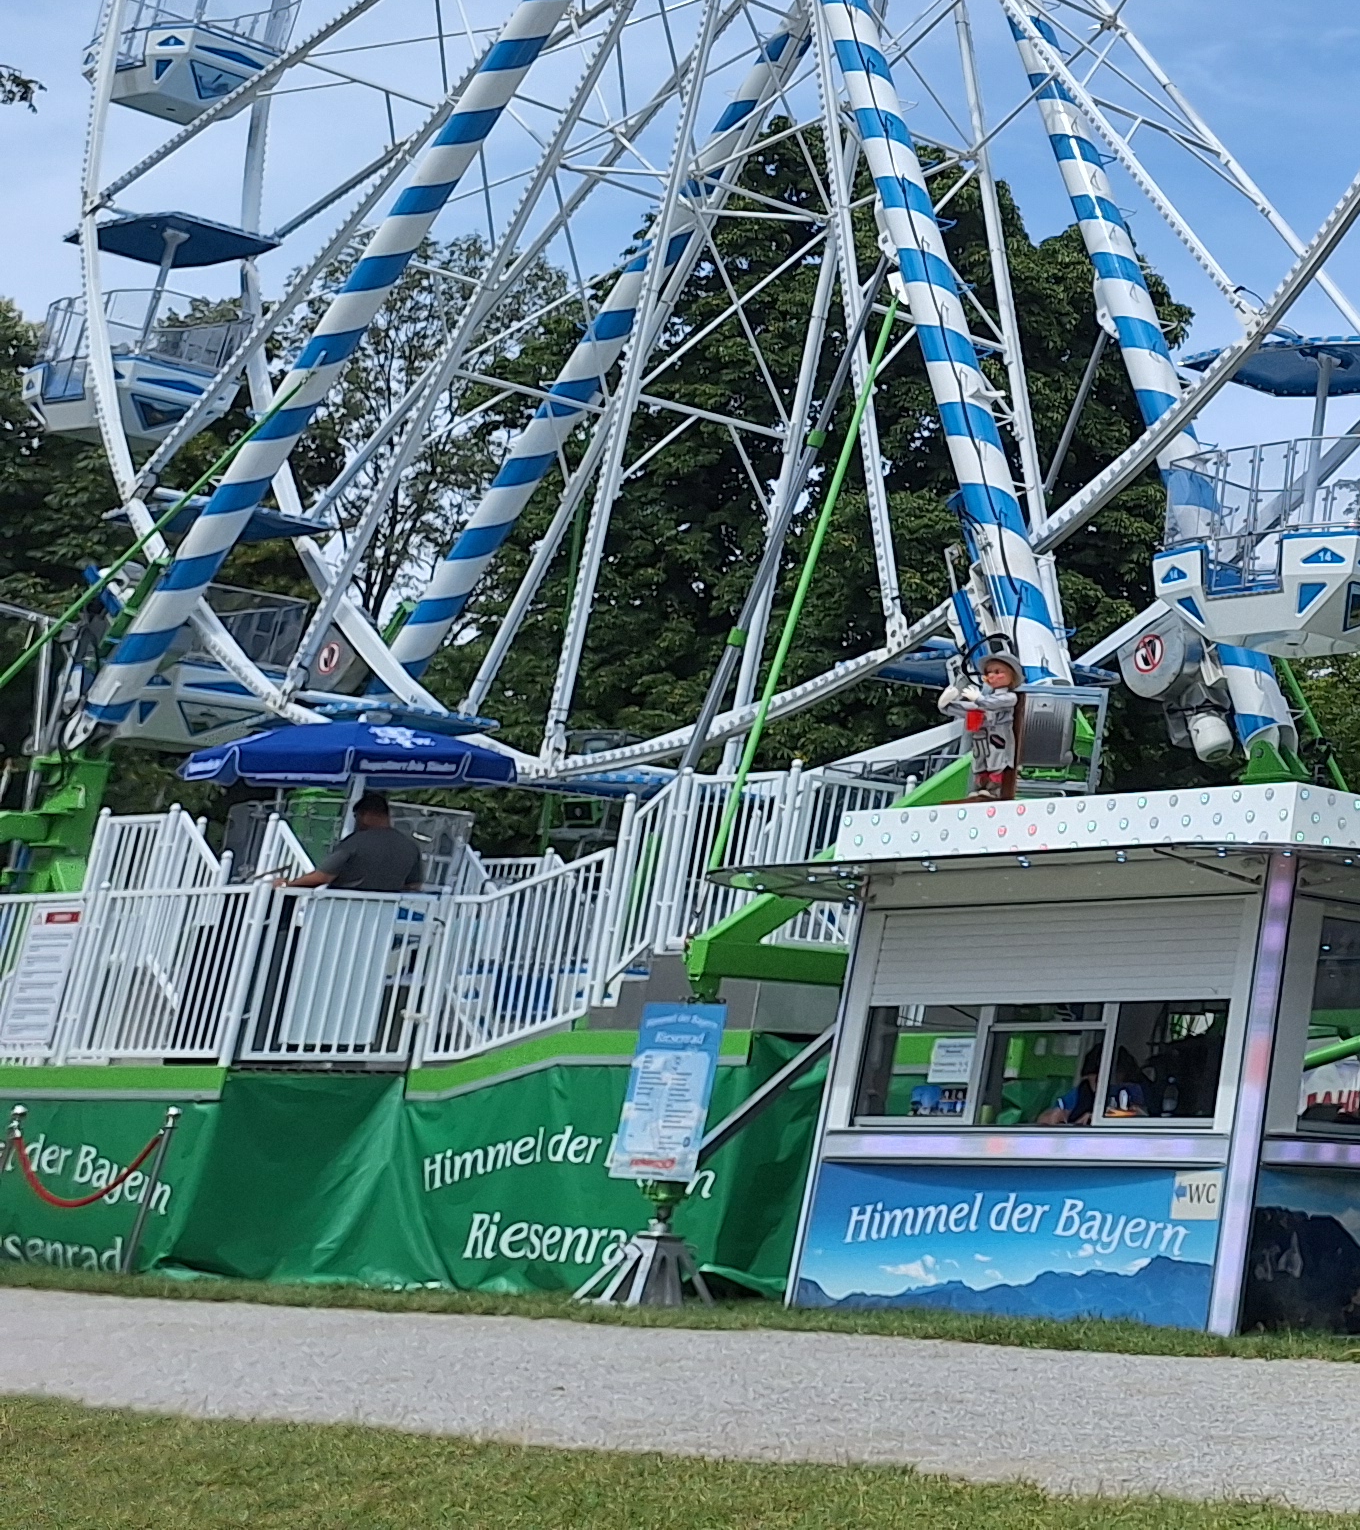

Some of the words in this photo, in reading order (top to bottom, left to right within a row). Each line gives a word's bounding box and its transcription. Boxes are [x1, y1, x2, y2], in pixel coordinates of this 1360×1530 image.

[1317, 550, 1333, 561] 14
[25, 1133, 73, 1176] der
[73, 1144, 172, 1216] Bayern
[423, 1126, 546, 1192] Himmel
[547, 1125, 603, 1164] der
[1187, 1183, 1217, 1205] WC
[462, 1211, 629, 1266] Riesenra
[843, 1192, 983, 1244] Himmel
[988, 1192, 1050, 1234] der
[1053, 1197, 1191, 1256] Bayern
[0, 1235, 124, 1273] senrad
